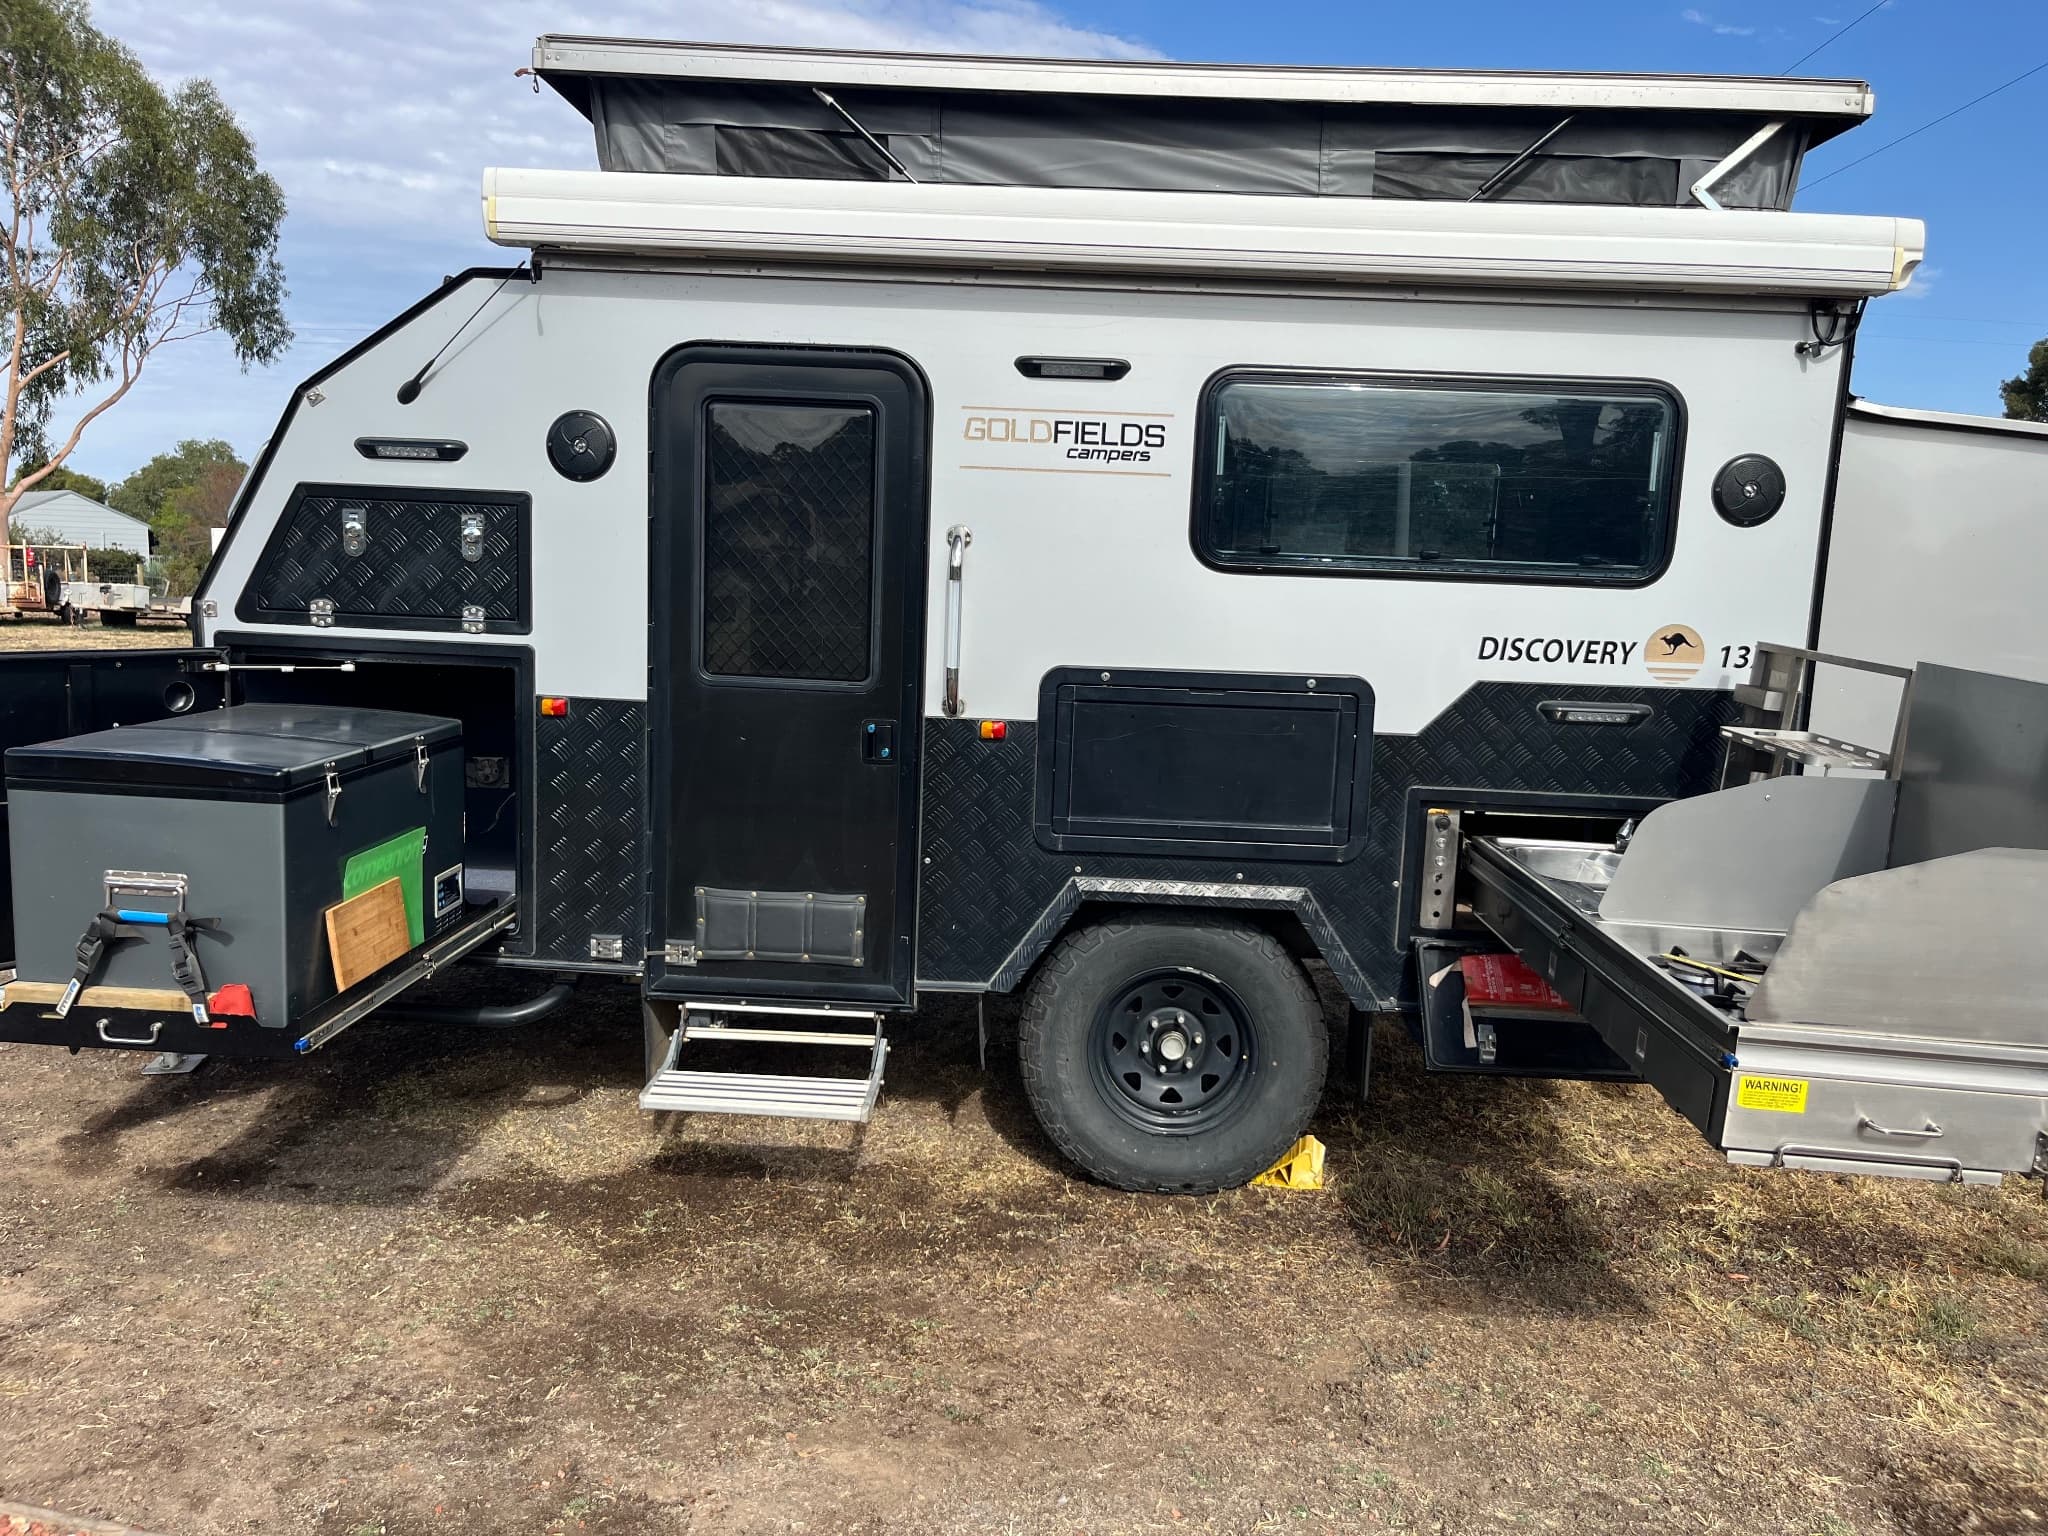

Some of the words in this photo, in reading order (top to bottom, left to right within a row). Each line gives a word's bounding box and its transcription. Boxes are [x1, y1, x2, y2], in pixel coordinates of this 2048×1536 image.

[963, 417, 1166, 448] GOLDFIELDS
[1066, 447, 1151, 464] campers
[1478, 636, 1638, 665] DISCOVERY
[1745, 1079, 1802, 1094] WARNING!
